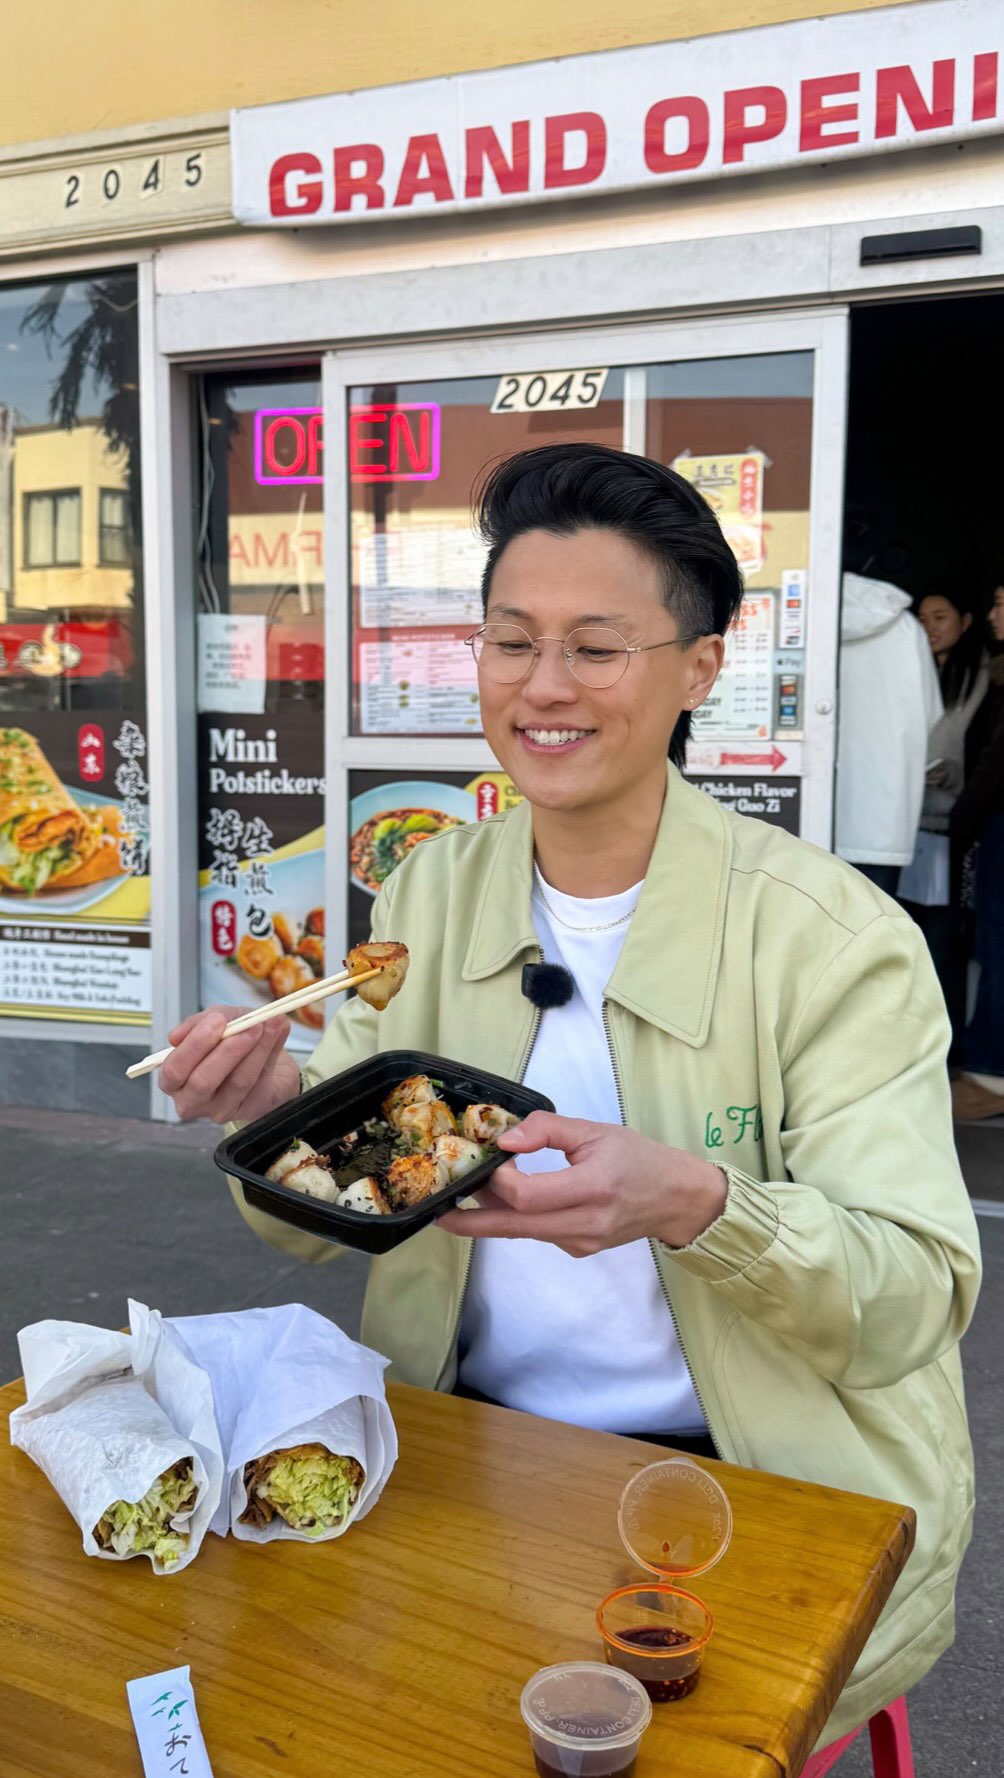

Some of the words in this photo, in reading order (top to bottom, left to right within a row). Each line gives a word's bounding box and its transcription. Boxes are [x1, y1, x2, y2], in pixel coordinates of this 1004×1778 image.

[65, 152, 203, 209] 2045
[269, 111, 607, 219] GRAND
[496, 372, 602, 410] 2045
[208, 728, 278, 763] Mini
[208, 767, 327, 796] Potstickers
[700, 782, 752, 797] Chicken
[753, 782, 798, 798] Flavor
[766, 798, 781, 813] Zi
[241, 816, 275, 939] 生煎包
[704, 1111, 725, 1148] le
[726, 1103, 763, 1144] Fl
